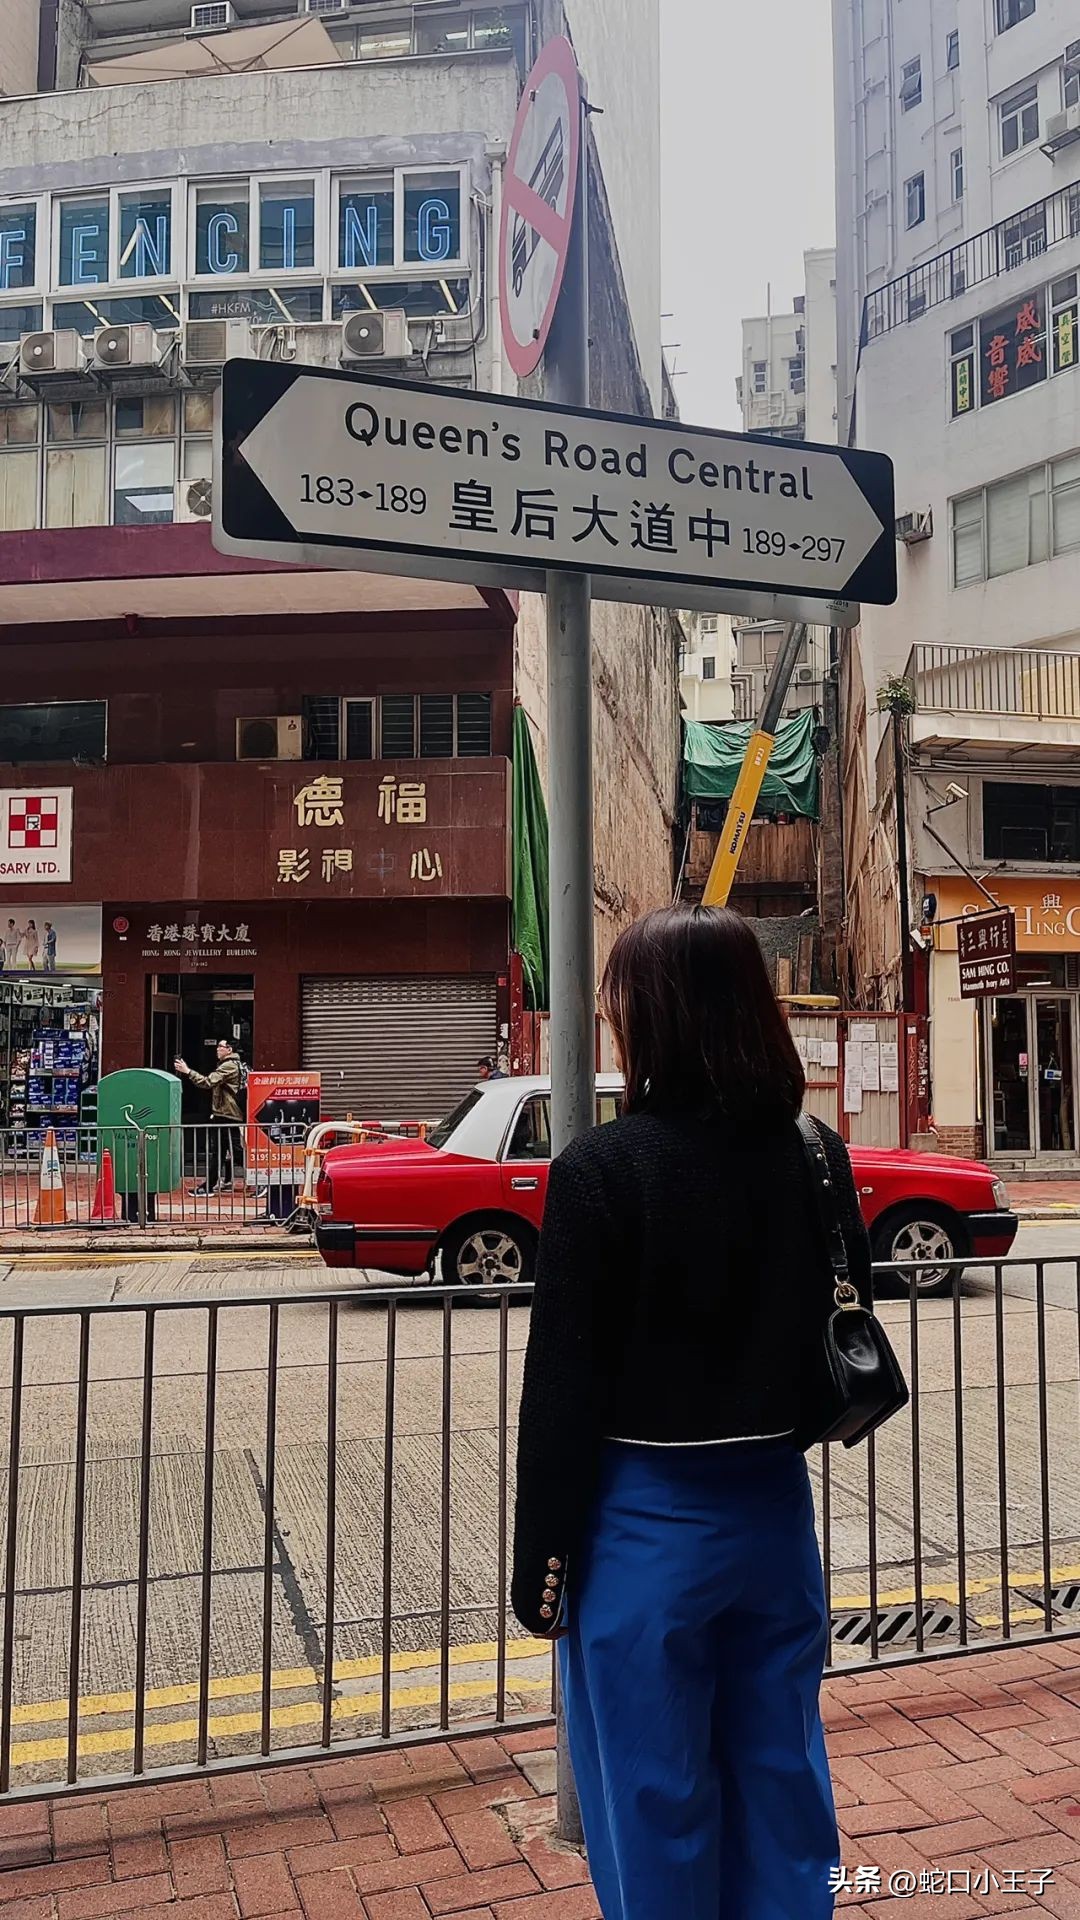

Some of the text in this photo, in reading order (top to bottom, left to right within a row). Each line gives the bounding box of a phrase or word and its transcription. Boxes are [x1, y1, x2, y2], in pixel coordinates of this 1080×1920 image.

[345, 402, 814, 500] Queen's Road Central
[449, 479, 730, 558] 皇后大道中
[294, 774, 427, 827] 德福
[729, 811, 746, 854] KOMATSU
[36, 861, 60, 874] LTD.
[142, 949, 160, 957] HONG
[163, 949, 181, 957] KONG
[185, 948, 222, 956] JEWELLERY
[962, 961, 1010, 979] SAM HING CO.
[999, 977, 1010, 986] Arts
